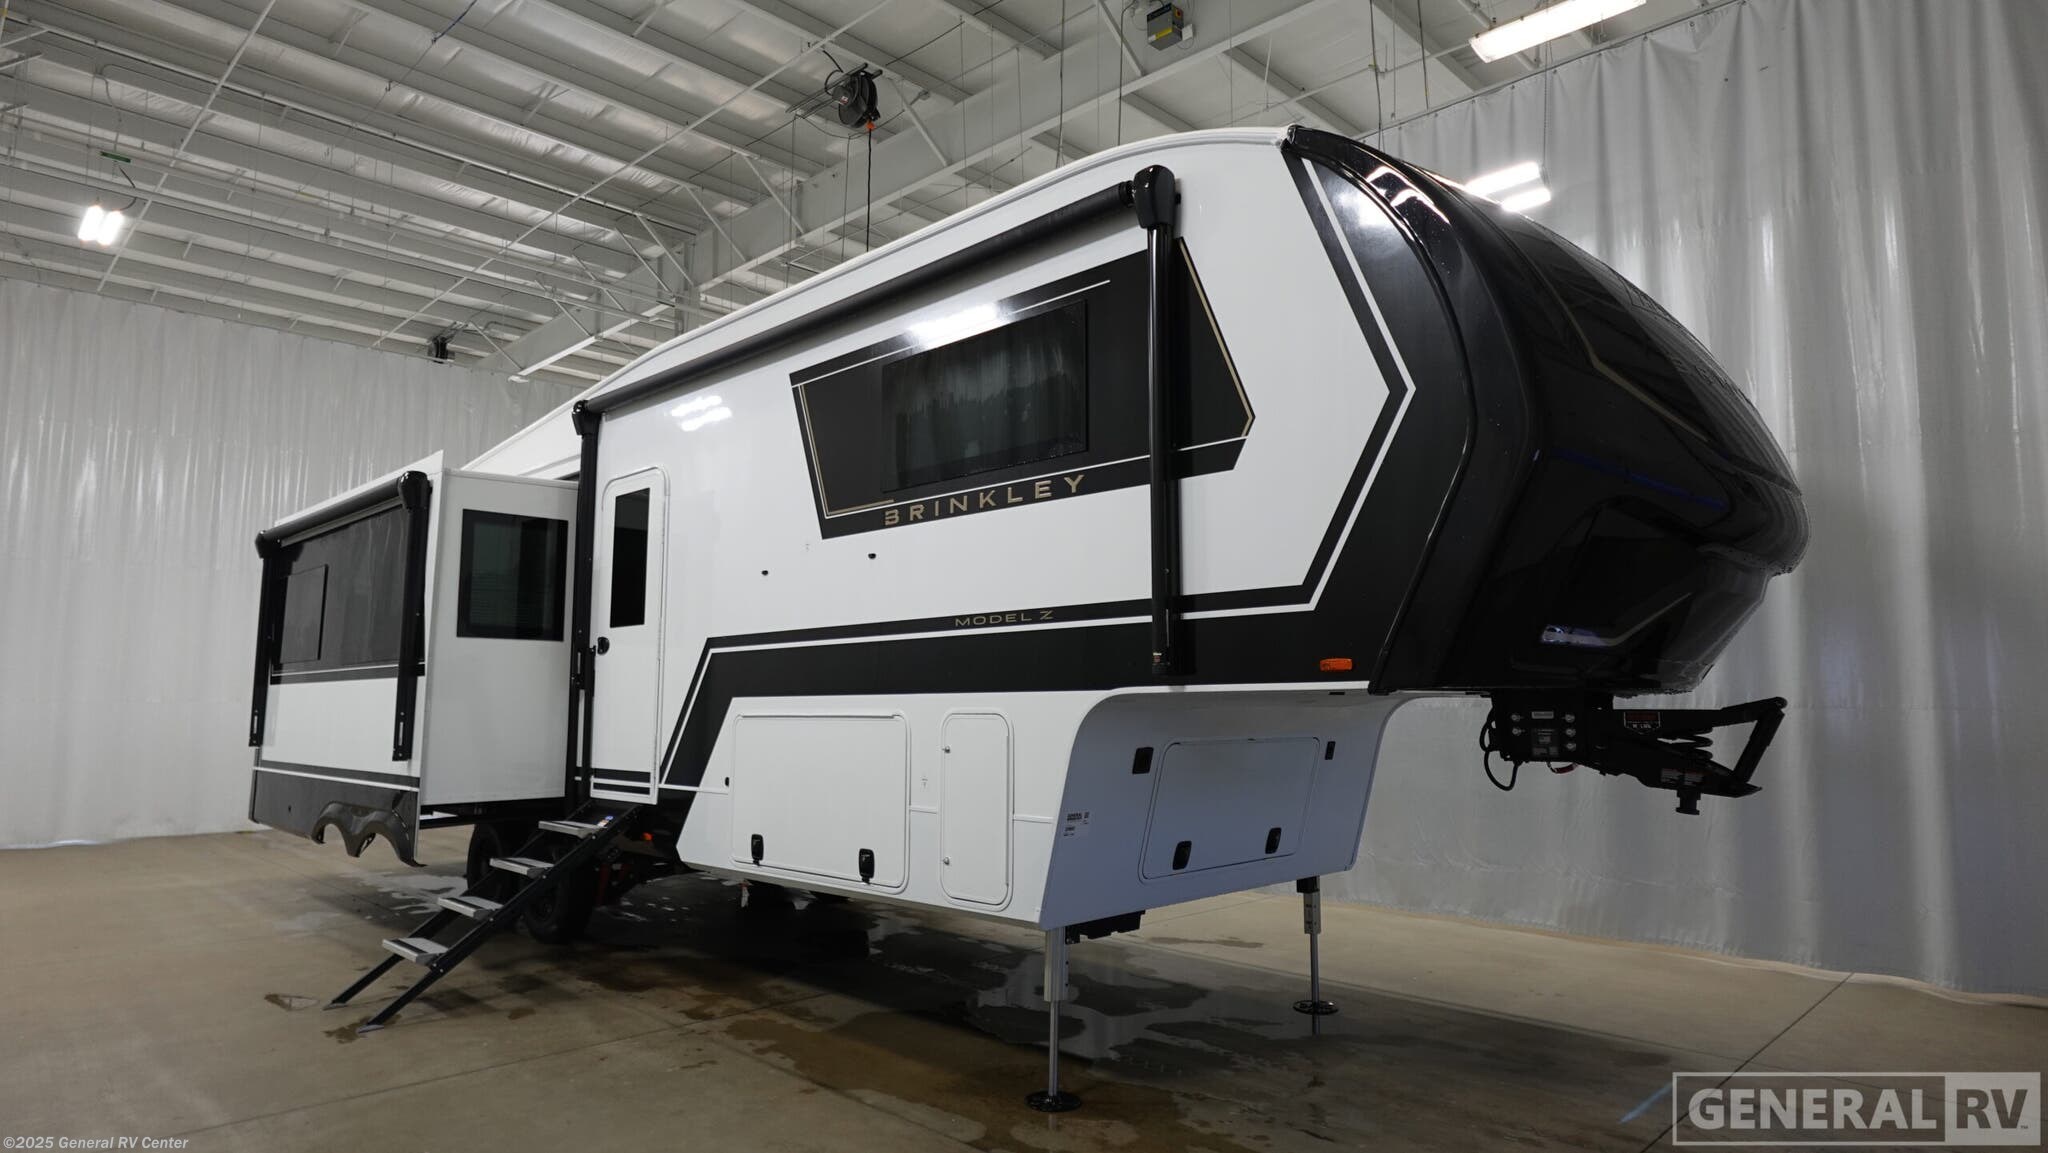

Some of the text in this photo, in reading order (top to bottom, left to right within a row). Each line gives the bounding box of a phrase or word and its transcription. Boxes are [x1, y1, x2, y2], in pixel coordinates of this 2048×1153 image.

[884, 474, 1085, 526] BRINKLEY
[954, 609, 1055, 627] MODEL Z
